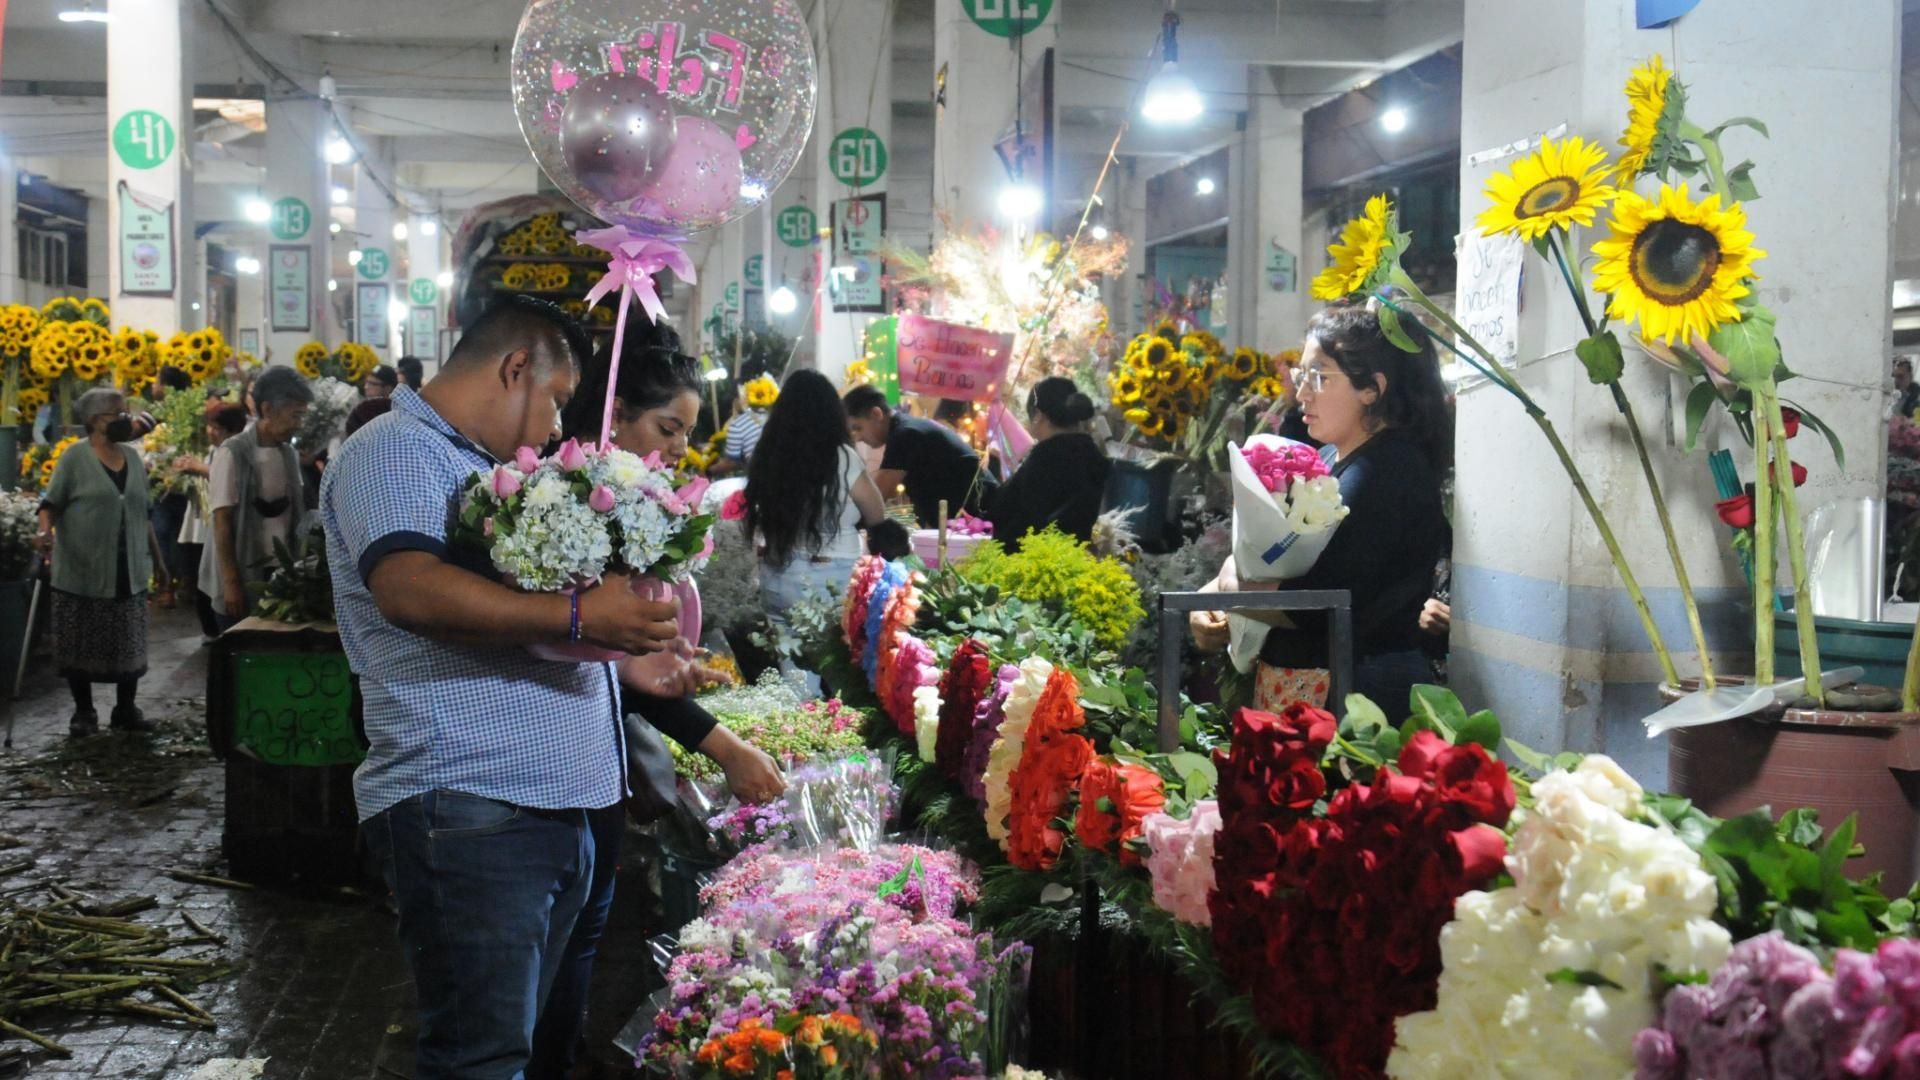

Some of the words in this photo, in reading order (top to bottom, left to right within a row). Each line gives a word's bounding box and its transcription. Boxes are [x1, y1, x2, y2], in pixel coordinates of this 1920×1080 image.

[130, 114, 165, 160] 41
[839, 139, 877, 177] 60
[783, 212, 811, 240] 58
